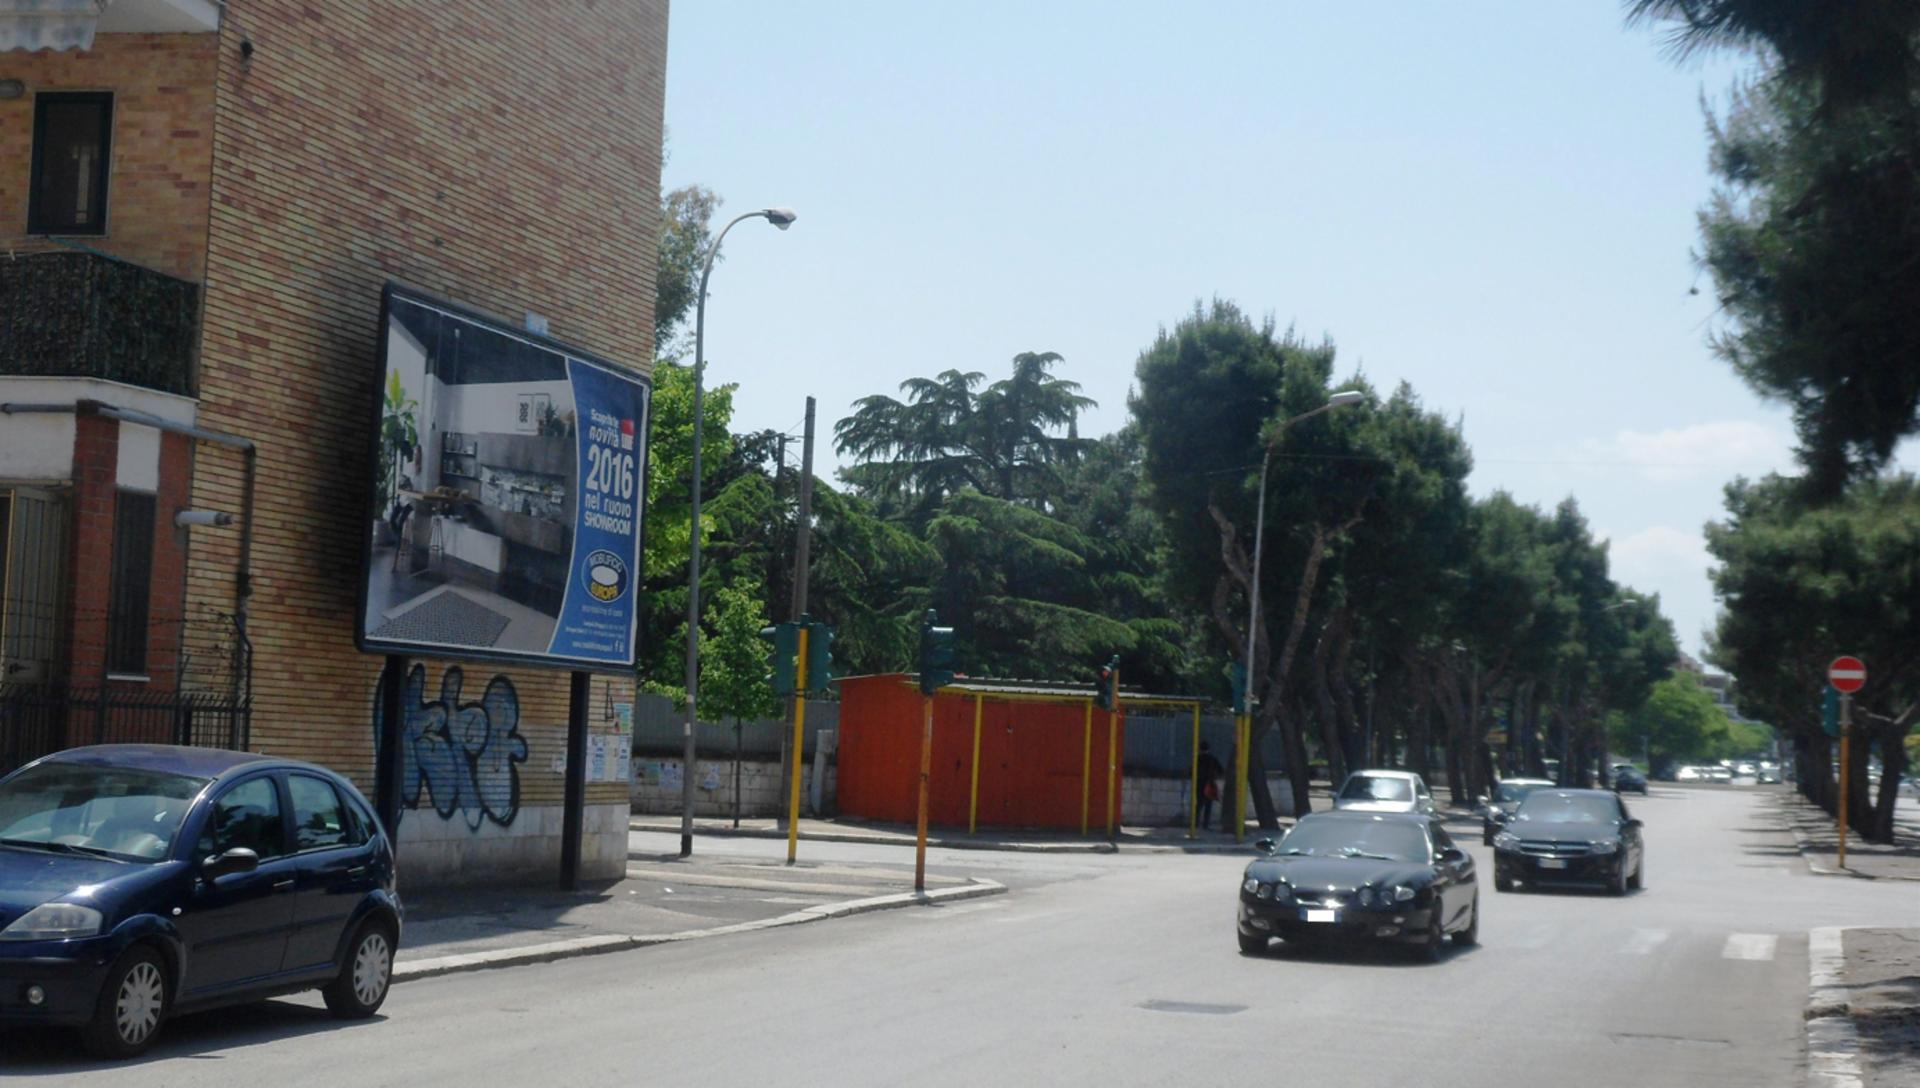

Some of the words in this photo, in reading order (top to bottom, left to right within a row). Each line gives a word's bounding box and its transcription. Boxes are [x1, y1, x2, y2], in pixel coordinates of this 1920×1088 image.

[589, 425, 619, 448] novità
[585, 444, 634, 499] 2016
[585, 492, 600, 511] nel
[603, 498, 632, 518] nuovo
[584, 510, 632, 535] SHOWROOM
